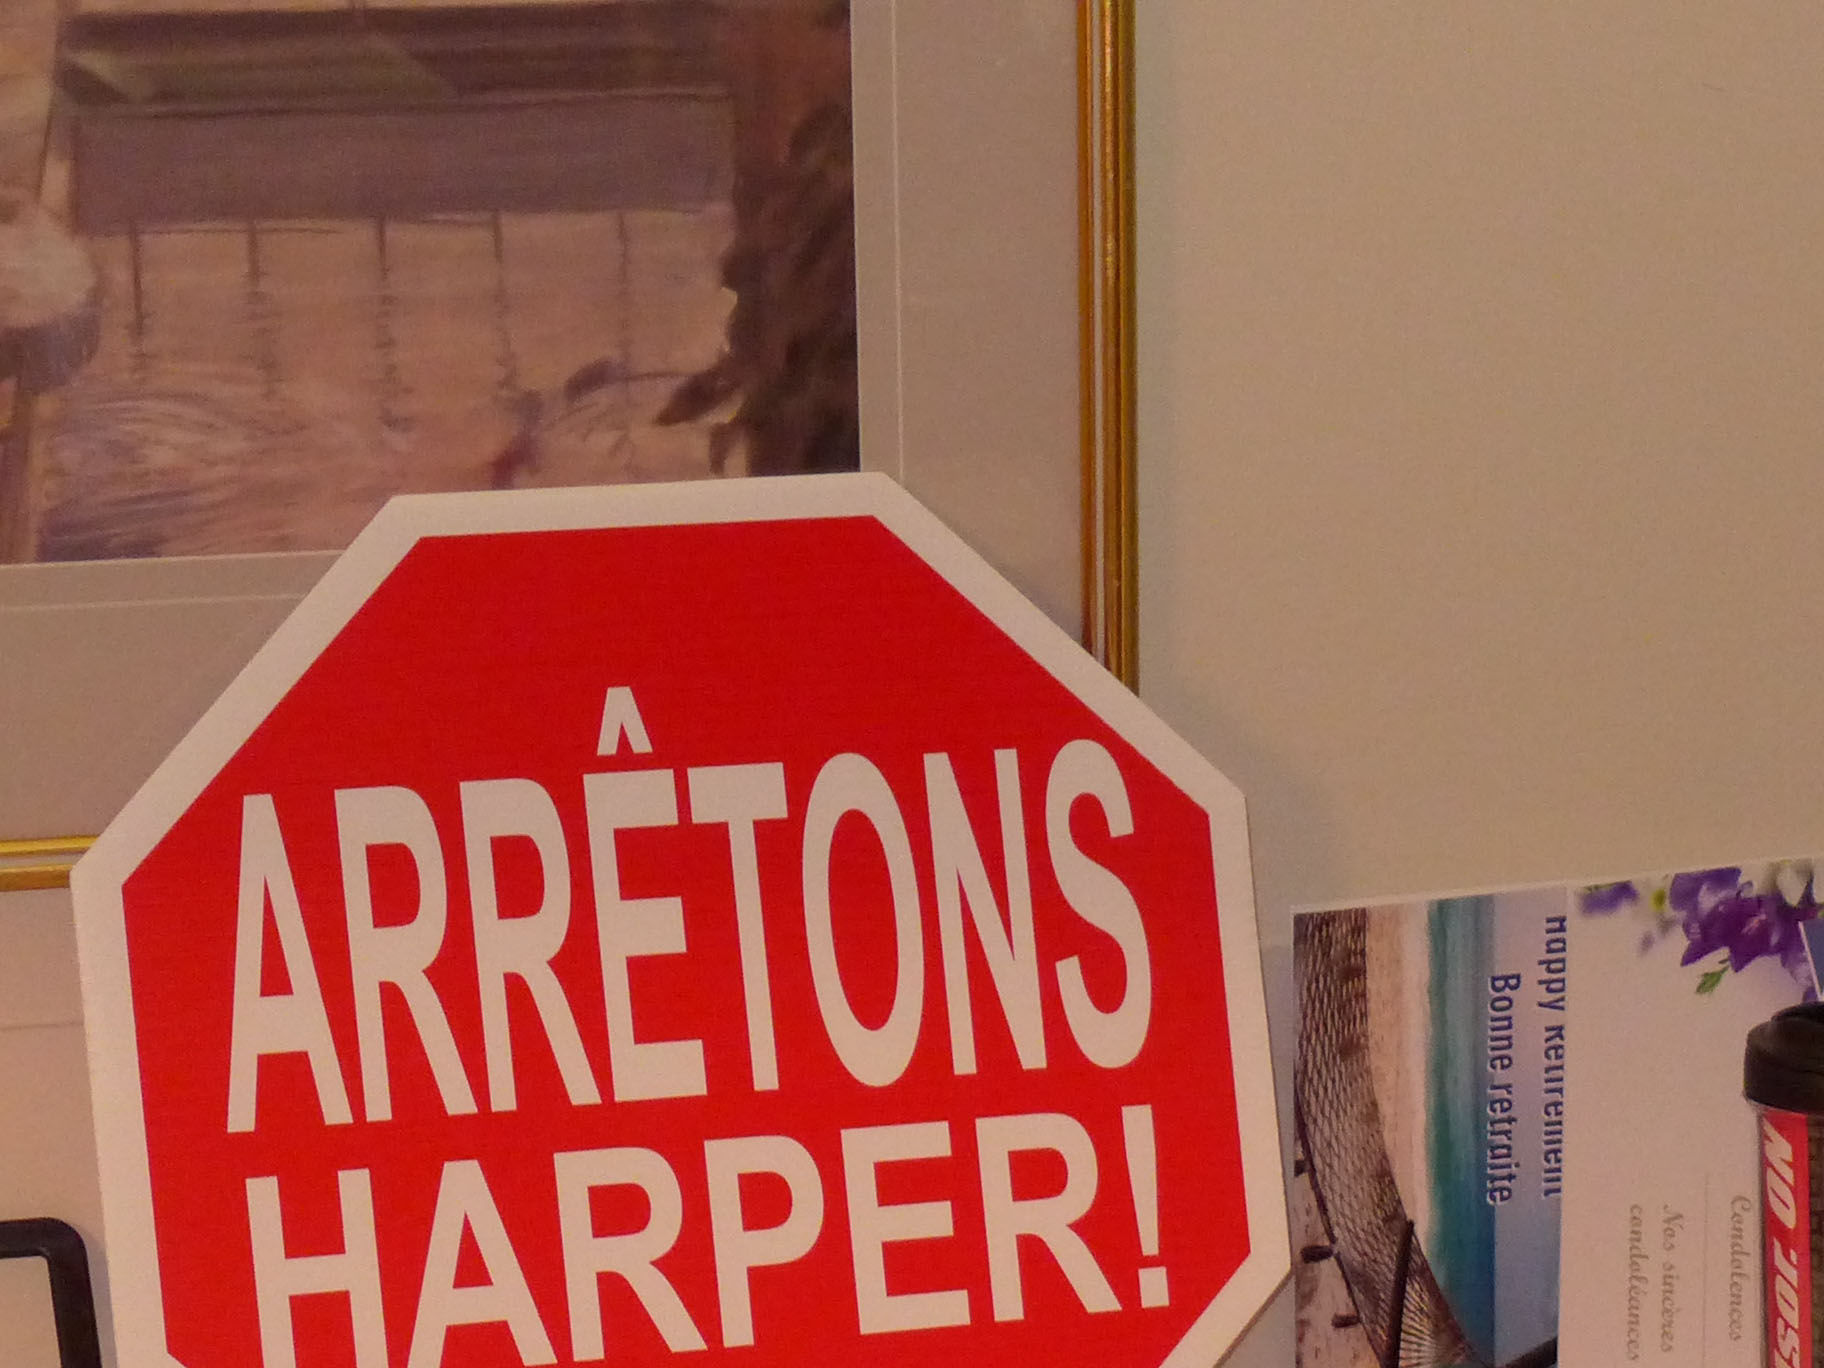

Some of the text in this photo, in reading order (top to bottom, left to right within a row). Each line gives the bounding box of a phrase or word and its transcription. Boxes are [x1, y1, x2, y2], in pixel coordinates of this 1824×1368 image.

[225, 686, 1154, 1134] ARRÊTONS
[1537, 915, 1567, 1011] Happy
[1487, 973, 1522, 1204] Bonne retraite
[1762, 1117, 1797, 1229] ON
[1627, 1203, 1650, 1361] condoléances
[1661, 1203, 1685, 1354] Nos sincères
[1729, 1195, 1753, 1342] Condolences
